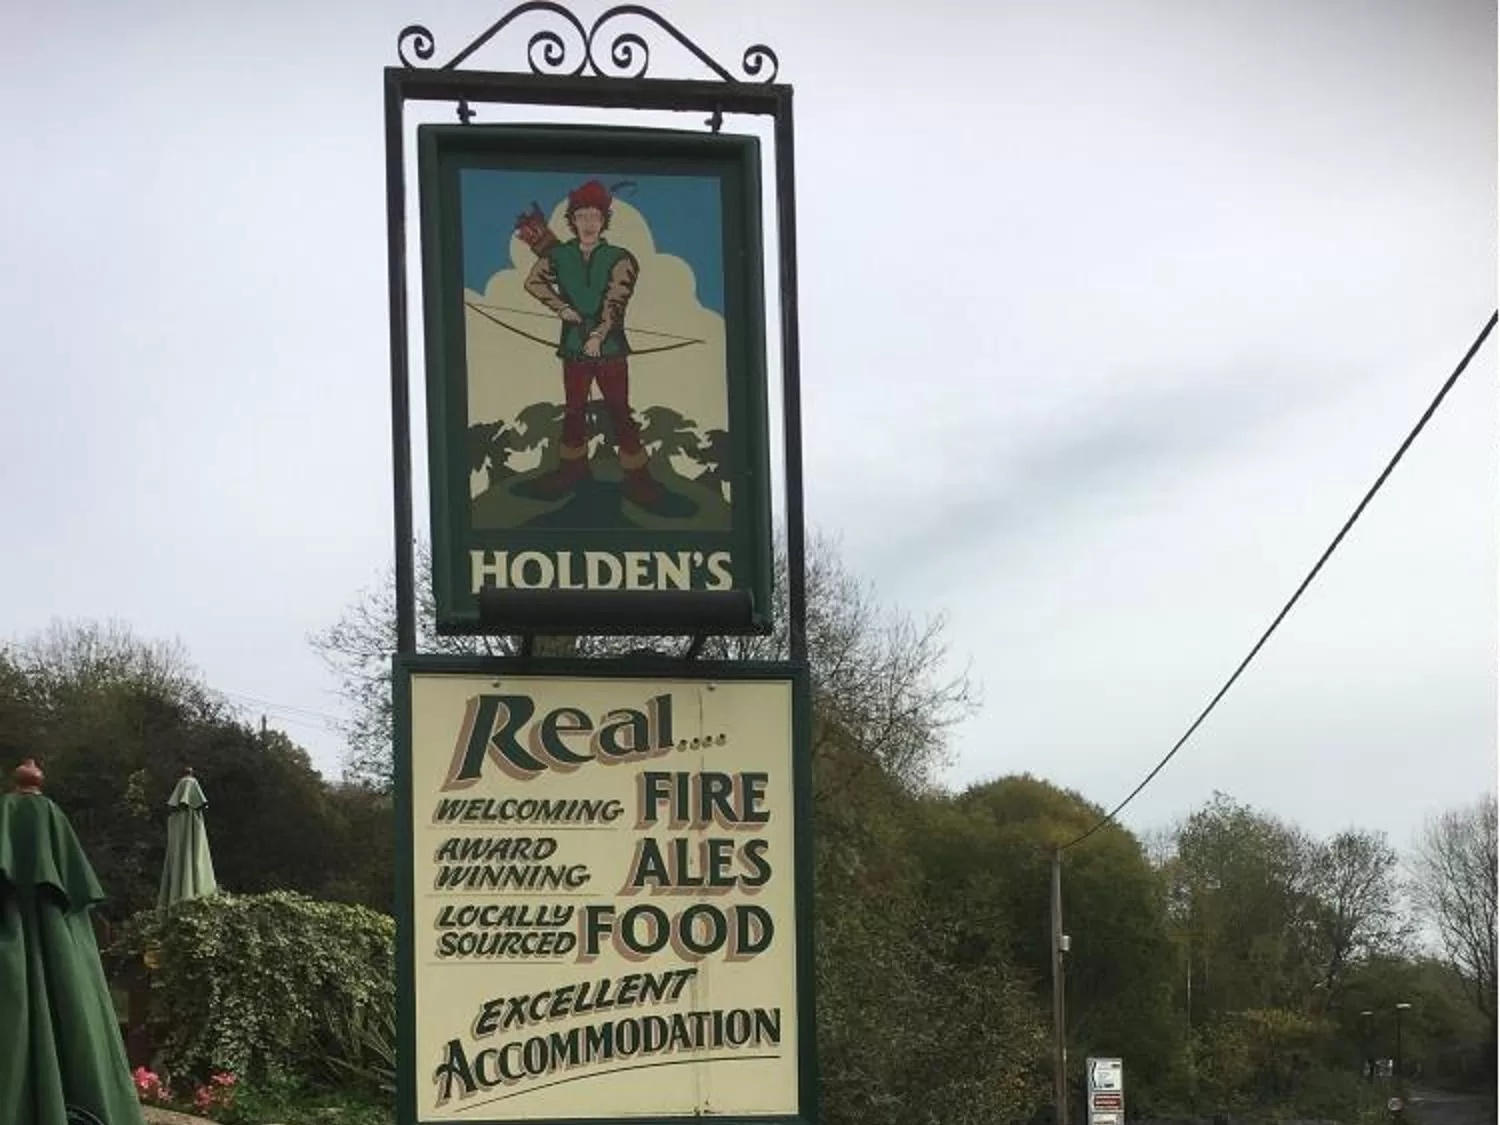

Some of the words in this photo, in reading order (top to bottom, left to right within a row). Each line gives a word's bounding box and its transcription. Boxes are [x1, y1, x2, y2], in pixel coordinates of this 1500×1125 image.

[469, 549, 733, 594] HOLDEN'S
[434, 798, 625, 825] WELCOMING
[638, 771, 771, 828] FIRE
[435, 837, 557, 863] AWARD
[624, 838, 773, 893] ALES
[435, 865, 591, 891] WINNING
[435, 905, 574, 930] LOCALLY
[578, 904, 774, 962] FOOD
[437, 932, 576, 958] SOURCED
[473, 968, 698, 1038] EXCELLENT
[434, 1007, 782, 1106] ACCOMMODATION
